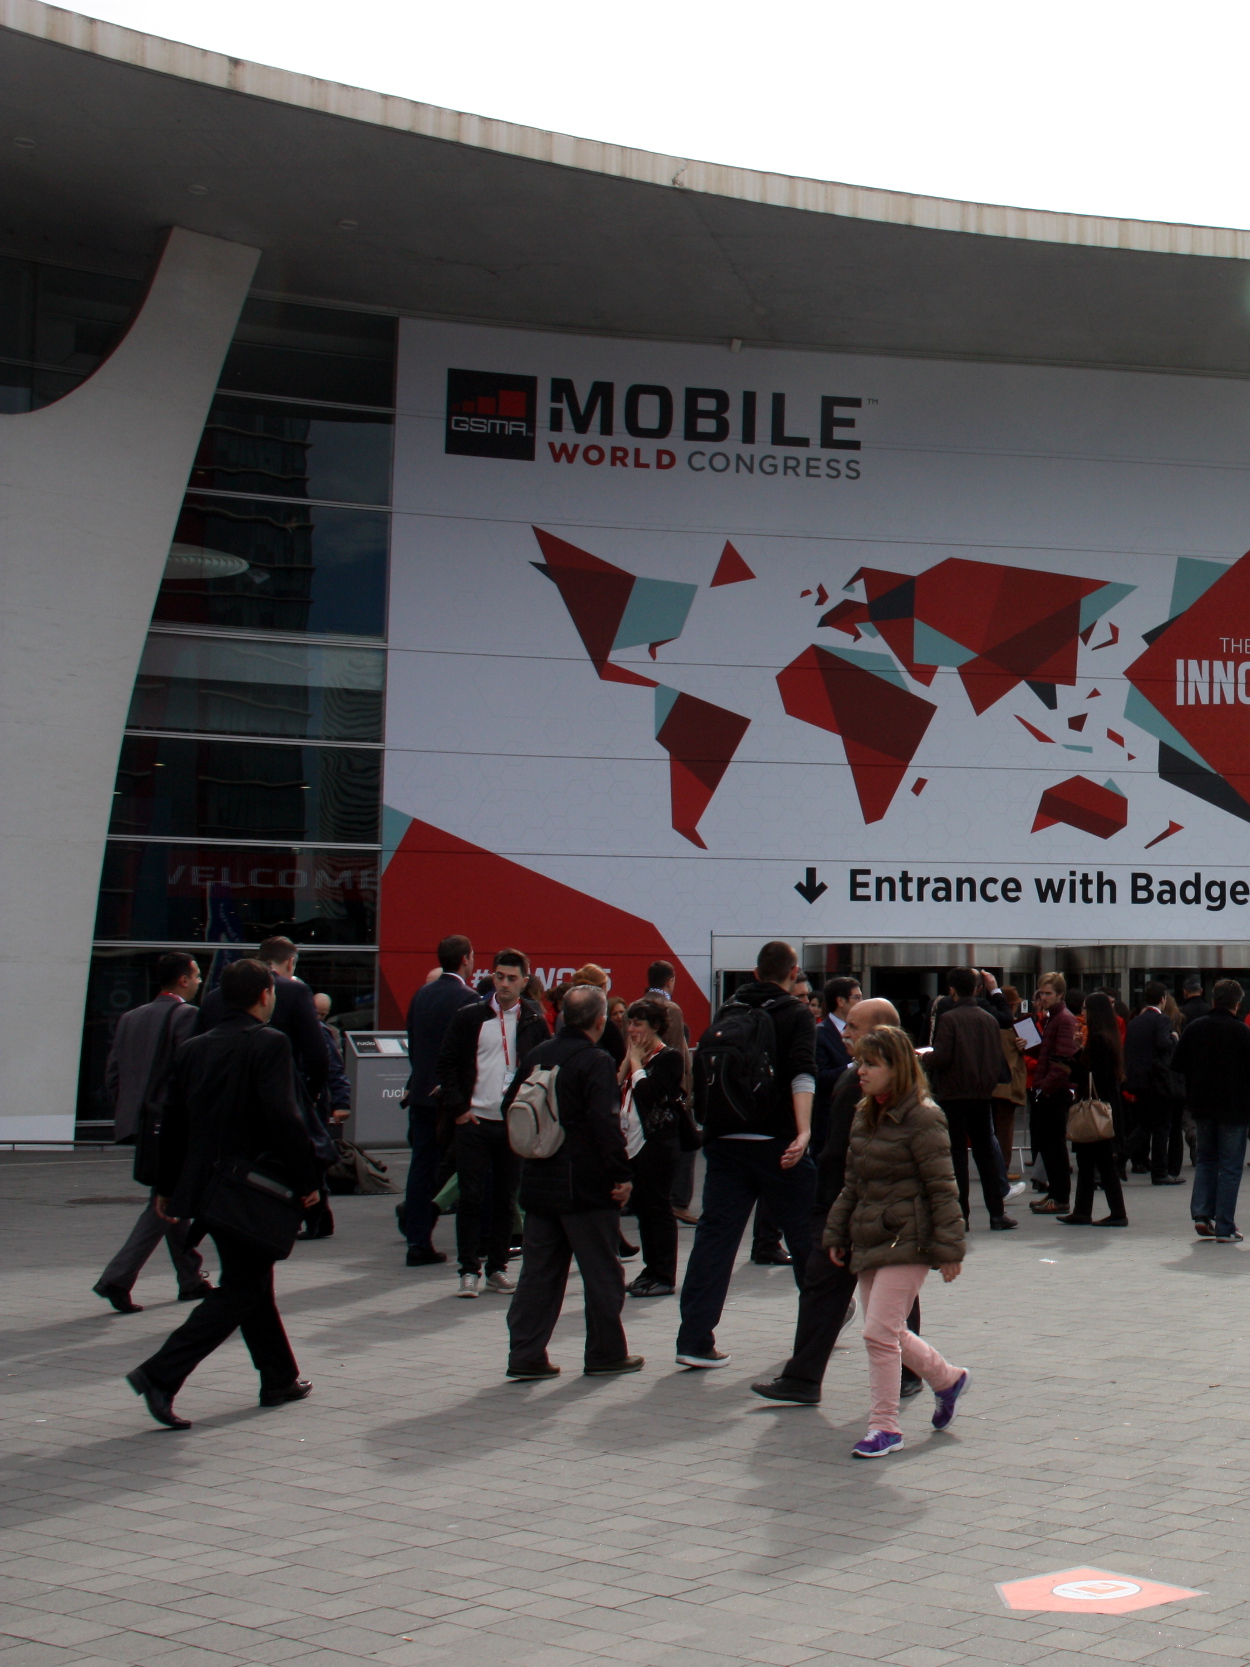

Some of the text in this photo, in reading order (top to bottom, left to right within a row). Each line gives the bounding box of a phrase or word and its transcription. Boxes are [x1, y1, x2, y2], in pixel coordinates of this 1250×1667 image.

[451, 416, 527, 436] GSMA
[550, 378, 861, 450] MOBILE
[548, 442, 861, 480] WORLD CONGRESS
[849, 868, 1250, 912] Entrance with Badge
[382, 1087, 405, 1098] nucl
